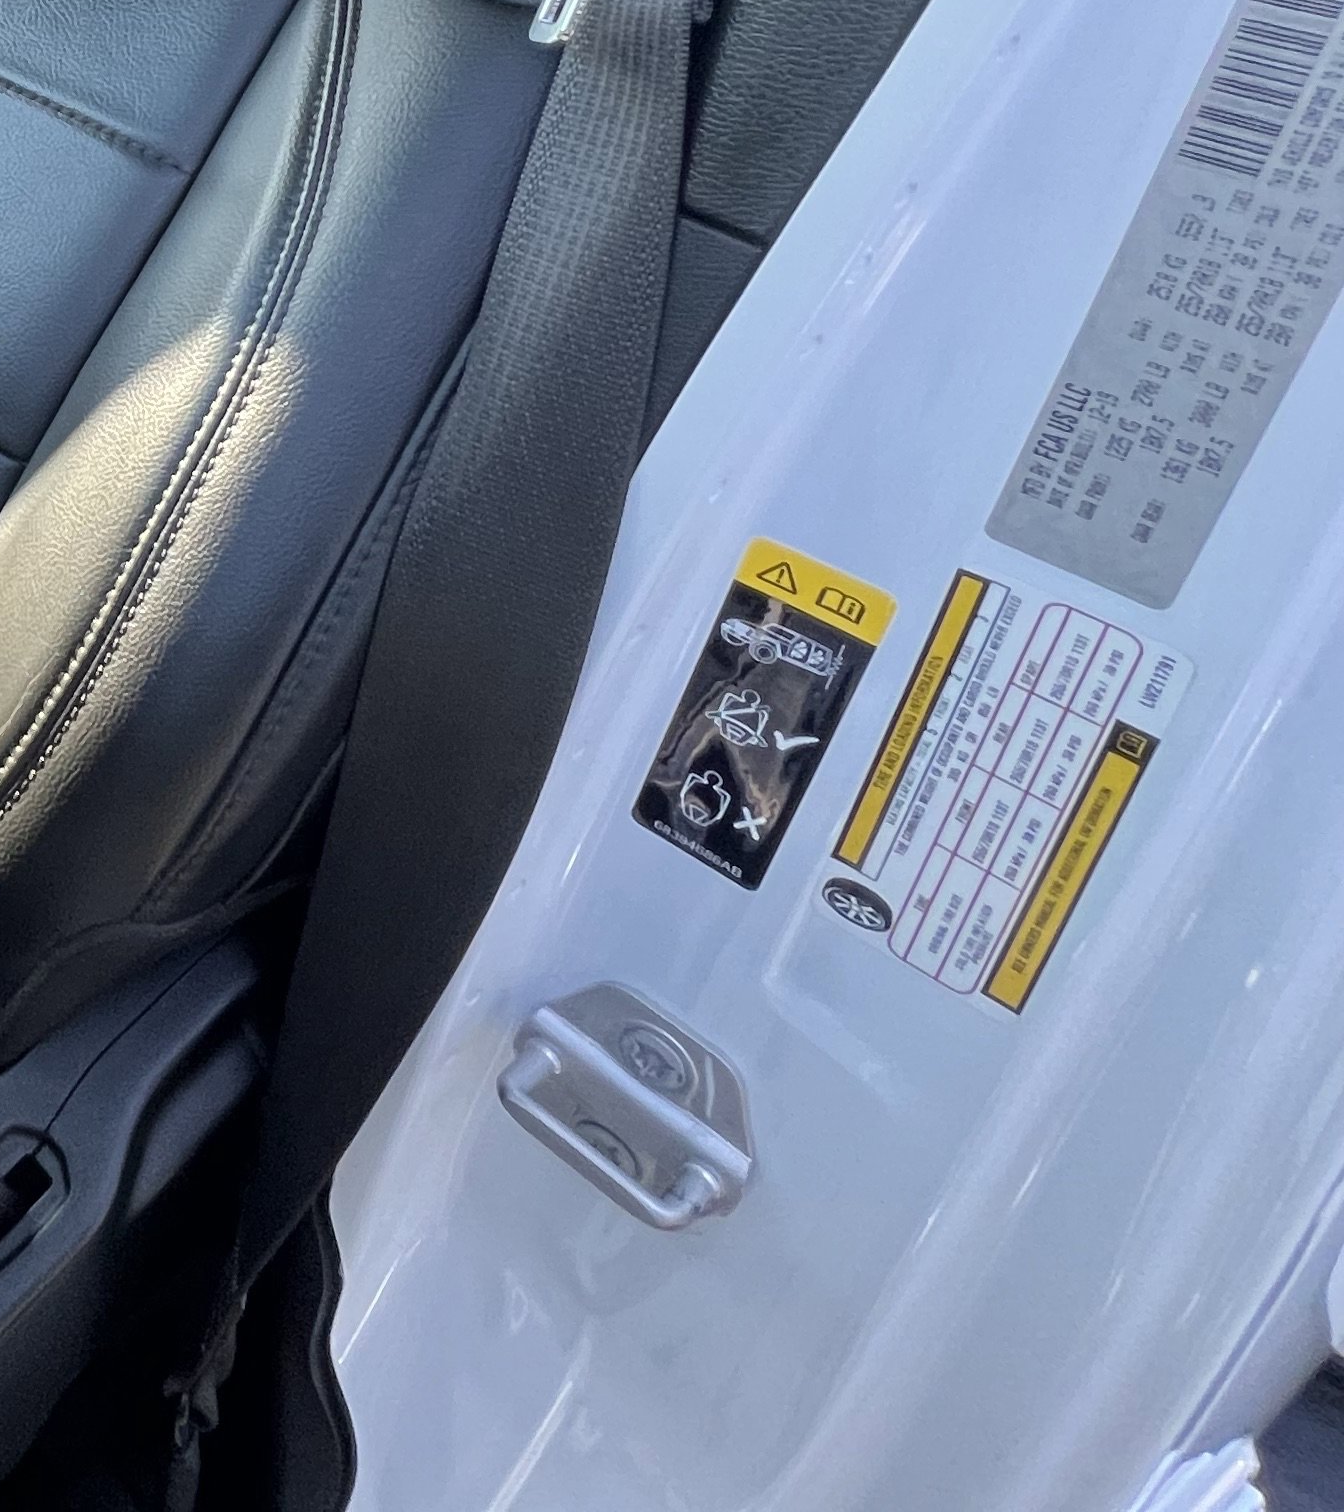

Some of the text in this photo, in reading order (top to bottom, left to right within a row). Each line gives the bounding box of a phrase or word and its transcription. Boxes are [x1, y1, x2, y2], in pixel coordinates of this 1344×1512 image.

[1142, 358, 1171, 381] LB
[1055, 379, 1093, 414] LLC
[1201, 378, 1230, 401] LB
[1046, 407, 1079, 435] US
[1031, 428, 1068, 463] FCA
[872, 651, 944, 793] TIRE AND LOADING INFORMATION
